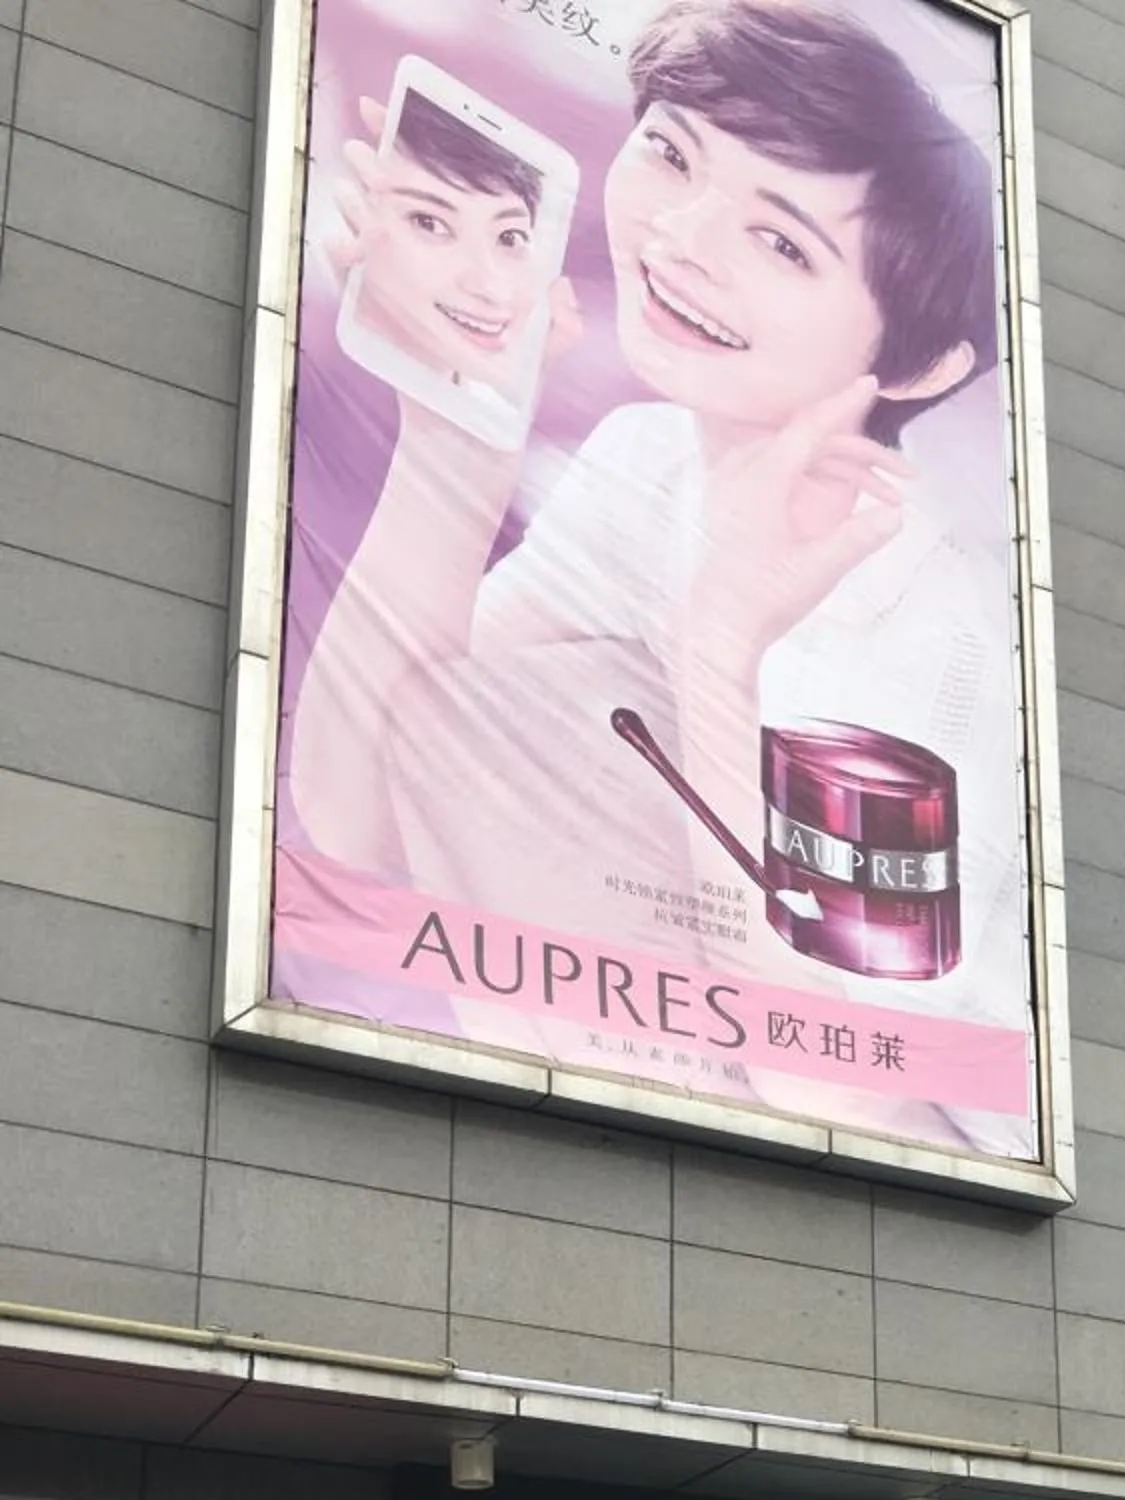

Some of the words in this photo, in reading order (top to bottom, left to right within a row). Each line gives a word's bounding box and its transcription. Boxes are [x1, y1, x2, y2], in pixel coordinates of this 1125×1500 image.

[787, 829, 947, 890] AUPRES
[400, 911, 747, 1049] AUPRES
[767, 1011, 905, 1072] 欧珀莱
